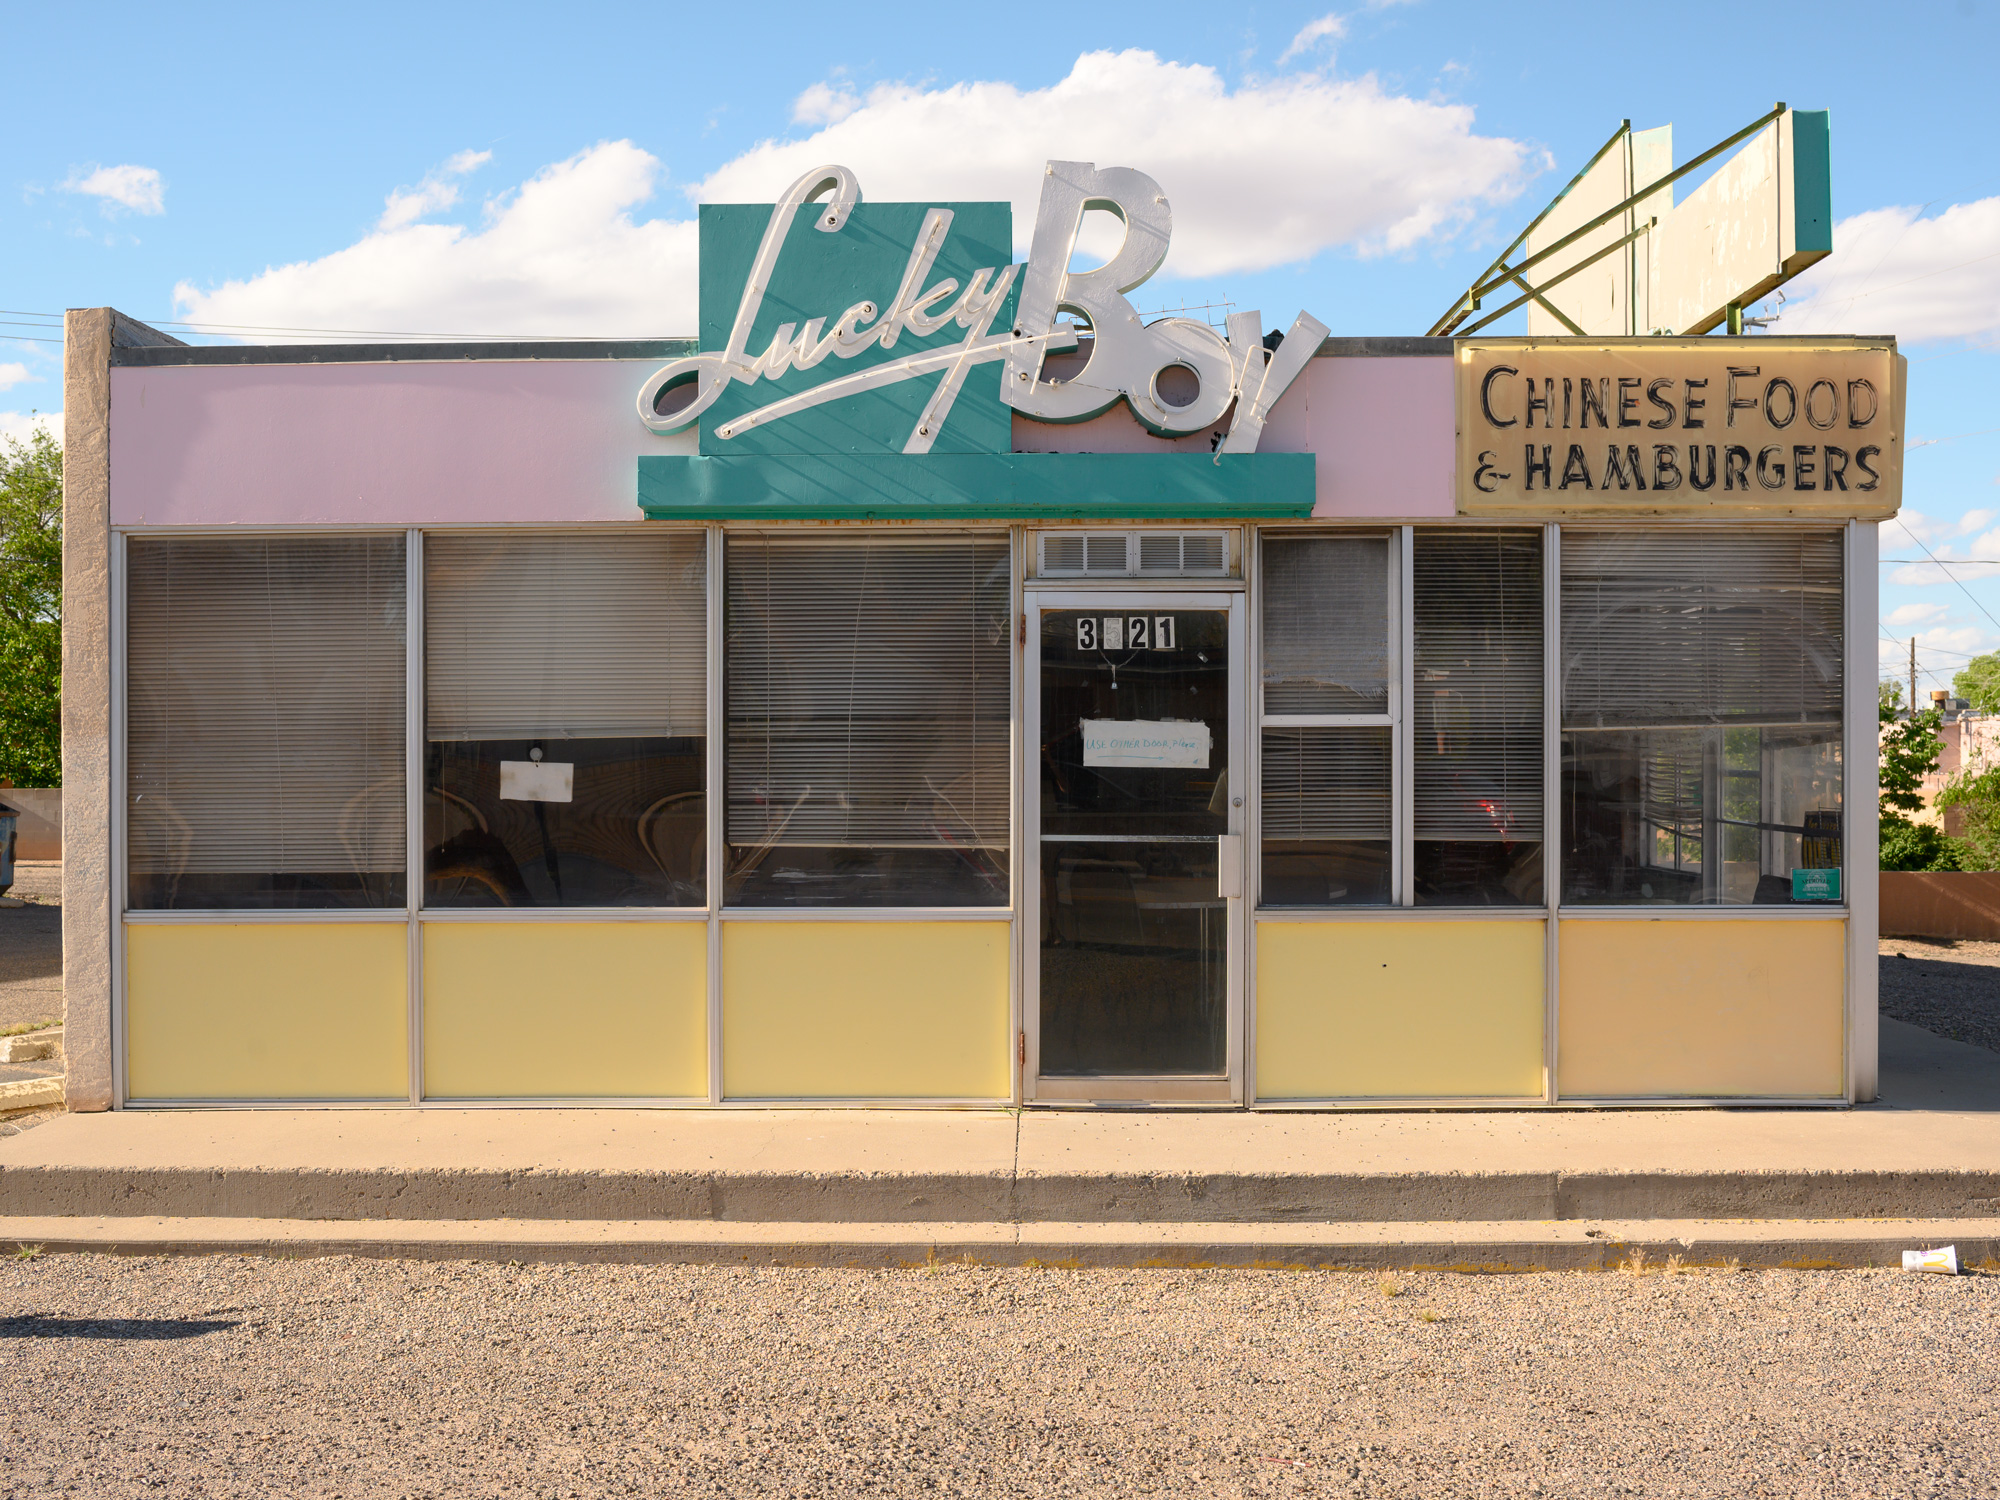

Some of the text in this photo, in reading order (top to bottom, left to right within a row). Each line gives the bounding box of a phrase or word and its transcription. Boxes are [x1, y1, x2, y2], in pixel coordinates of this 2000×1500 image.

[636, 160, 1331, 454] Lucky Boy
[1479, 365, 1878, 431] CHINESE FOOD
[1473, 443, 1881, 493] & HAMBURGERS
[1086, 739, 1107, 750] USE
[1110, 738, 1140, 749] OTHER
